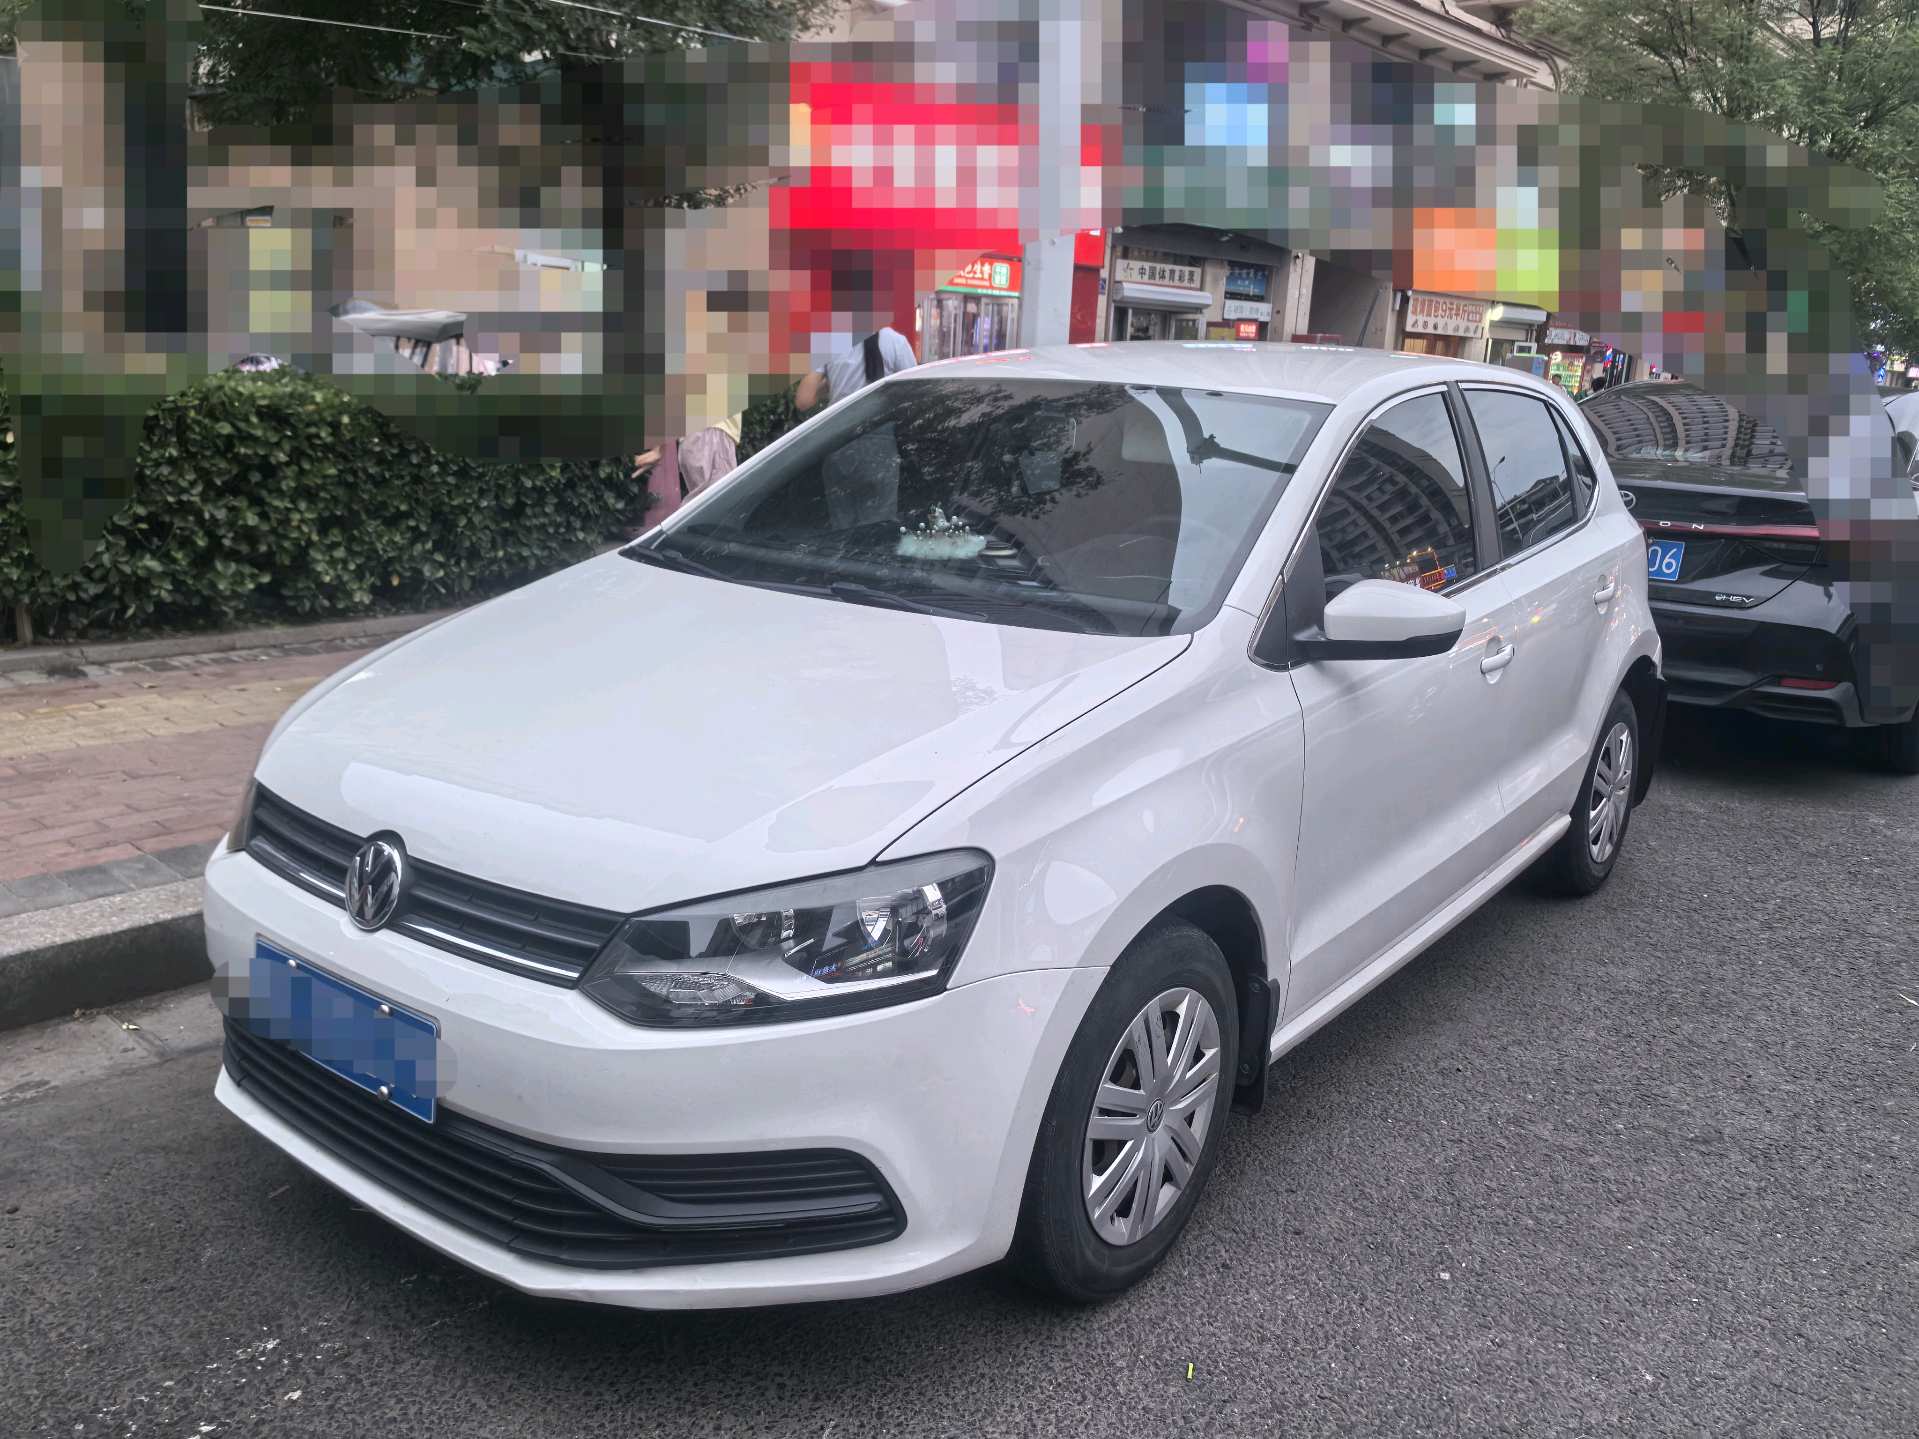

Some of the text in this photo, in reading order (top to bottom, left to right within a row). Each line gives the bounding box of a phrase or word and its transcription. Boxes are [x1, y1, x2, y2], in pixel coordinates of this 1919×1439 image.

[1138, 264, 1195, 288] 中国体育彩票
